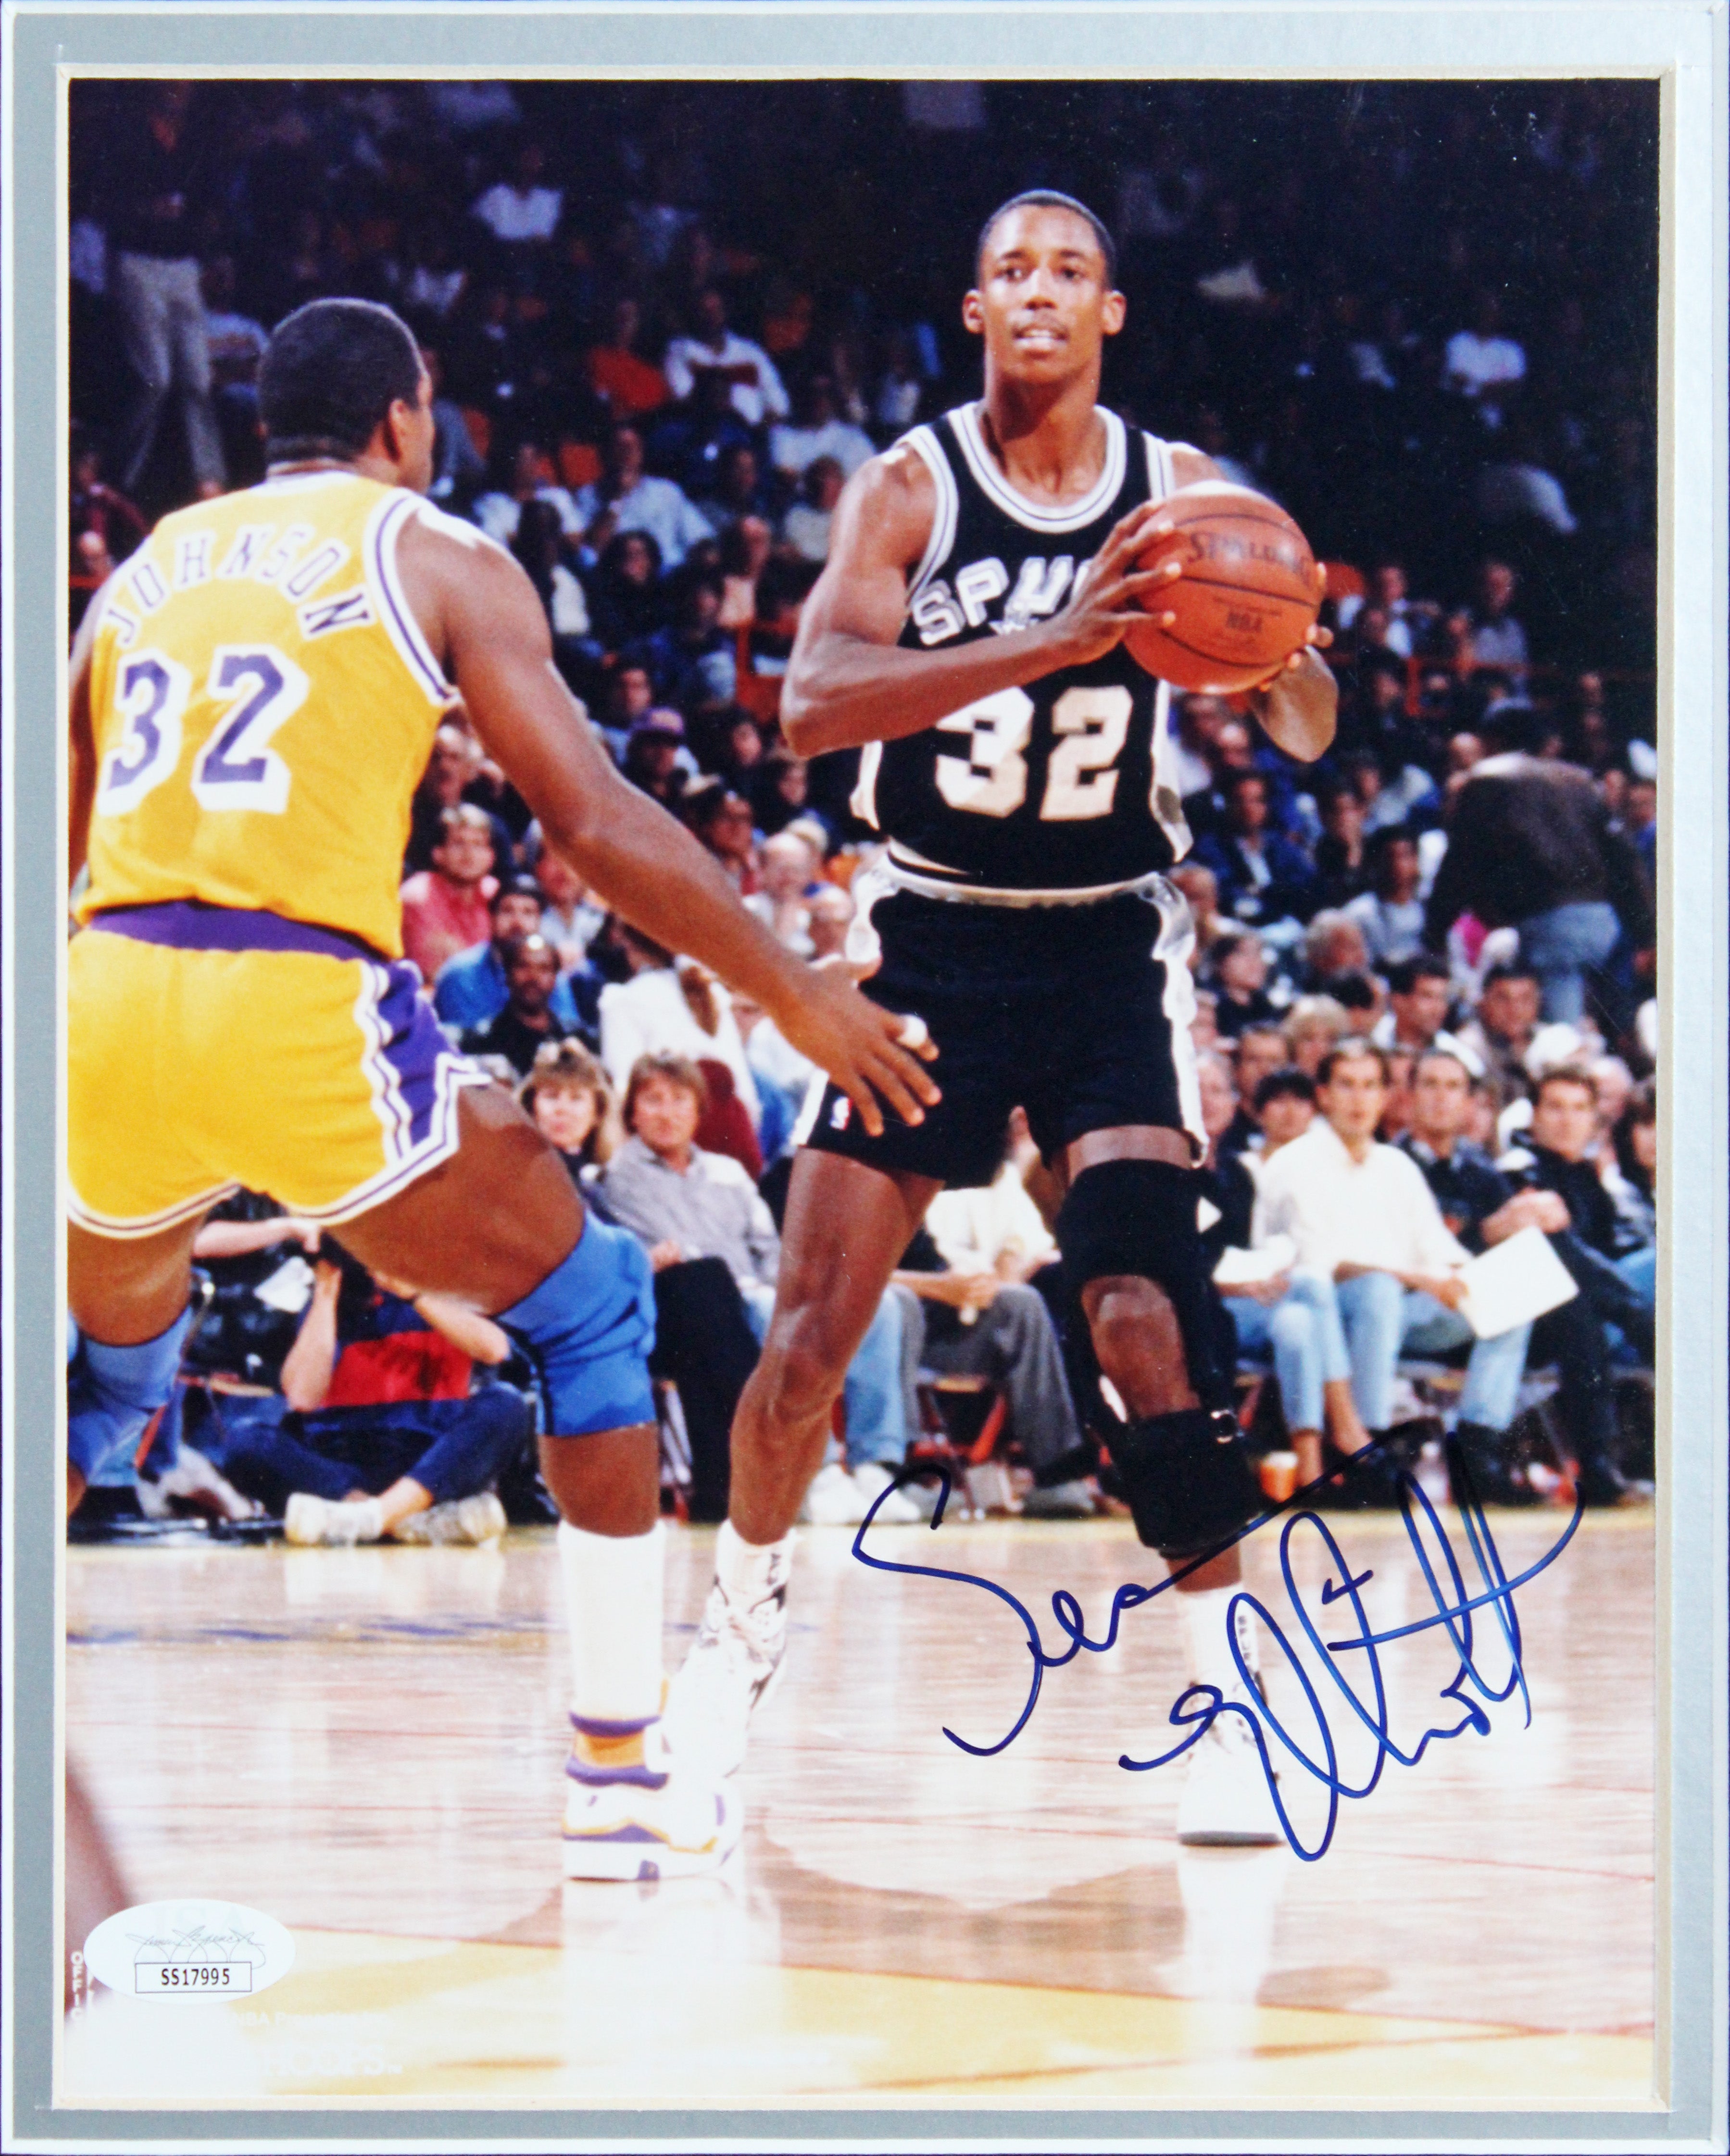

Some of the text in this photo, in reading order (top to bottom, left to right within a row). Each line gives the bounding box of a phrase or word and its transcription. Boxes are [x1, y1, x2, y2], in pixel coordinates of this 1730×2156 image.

[102, 525, 376, 647] JOHNSON
[912, 555, 1094, 646] SPU
[1225, 610, 1263, 634] NBA
[98, 646, 310, 815] 32
[935, 686, 1134, 821] 32
[161, 1968, 231, 1986] SS17995
